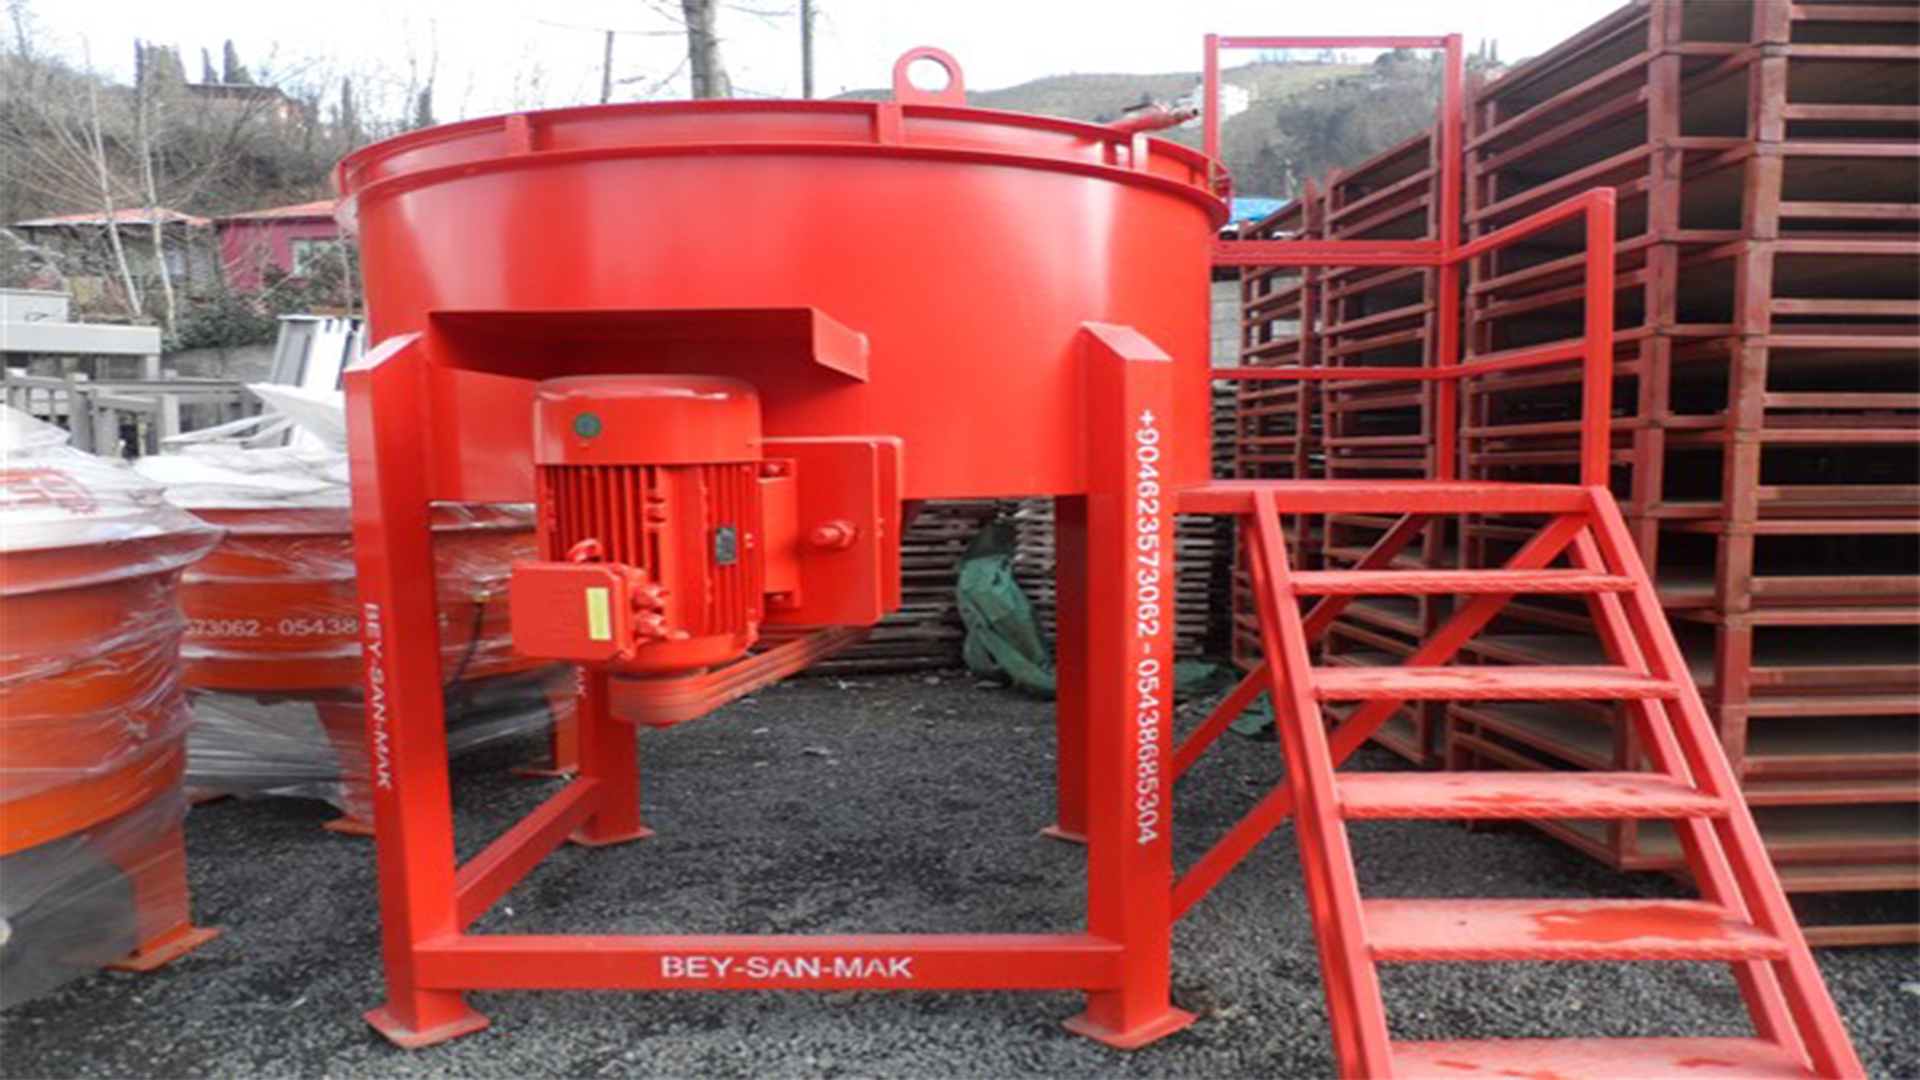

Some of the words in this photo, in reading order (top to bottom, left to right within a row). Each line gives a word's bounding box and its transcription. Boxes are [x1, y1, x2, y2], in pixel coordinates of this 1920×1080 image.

[1136, 409, 1160, 637] +904623573062
[364, 603, 392, 789] BEY-SAN-MAK
[1136, 658, 1160, 845] 05438685304
[660, 955, 914, 979] BEY-SAN-MAK
